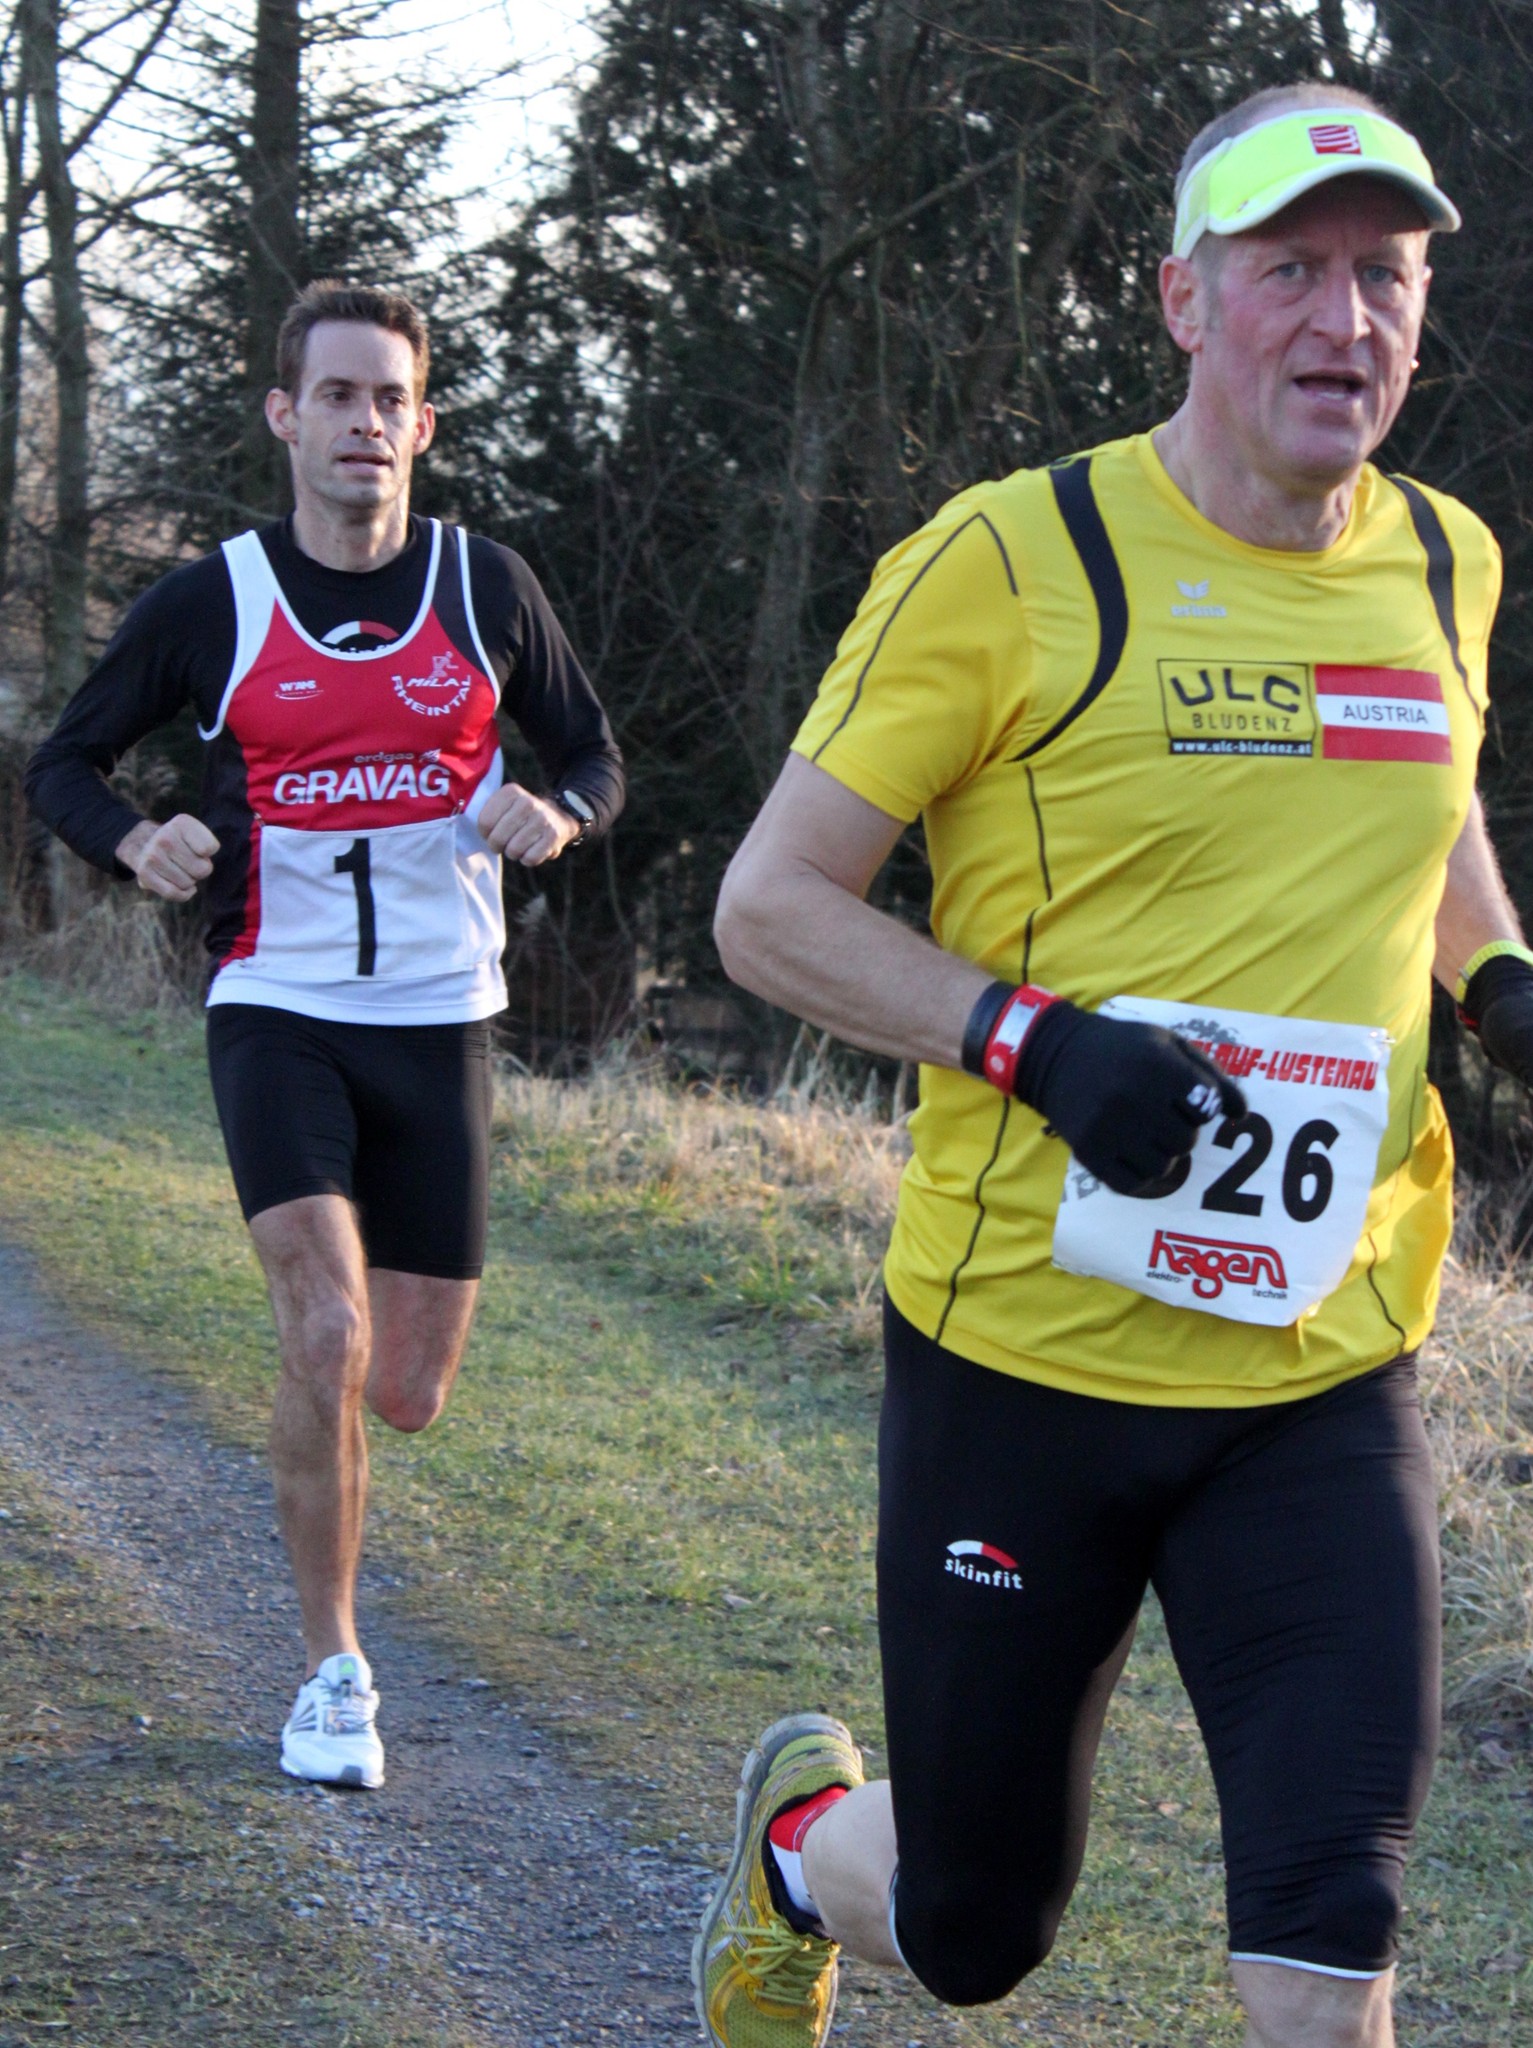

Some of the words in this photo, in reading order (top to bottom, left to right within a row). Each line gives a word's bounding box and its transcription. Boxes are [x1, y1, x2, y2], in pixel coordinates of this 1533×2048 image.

[391, 674, 472, 717] RHEINTAL
[1170, 667, 1301, 714] ULC
[1192, 713, 1294, 733] BLUDENZ
[1342, 704, 1430, 725] AUSTRIA
[1172, 740, 1313, 755] www.ulc-bludenz.at
[273, 763, 451, 806] GRAVAG
[334, 837, 378, 977] 1
[1105, 1112, 1341, 1224] 26
[1148, 1229, 1288, 1299] hagen
[944, 1558, 1024, 1590] skinfit
